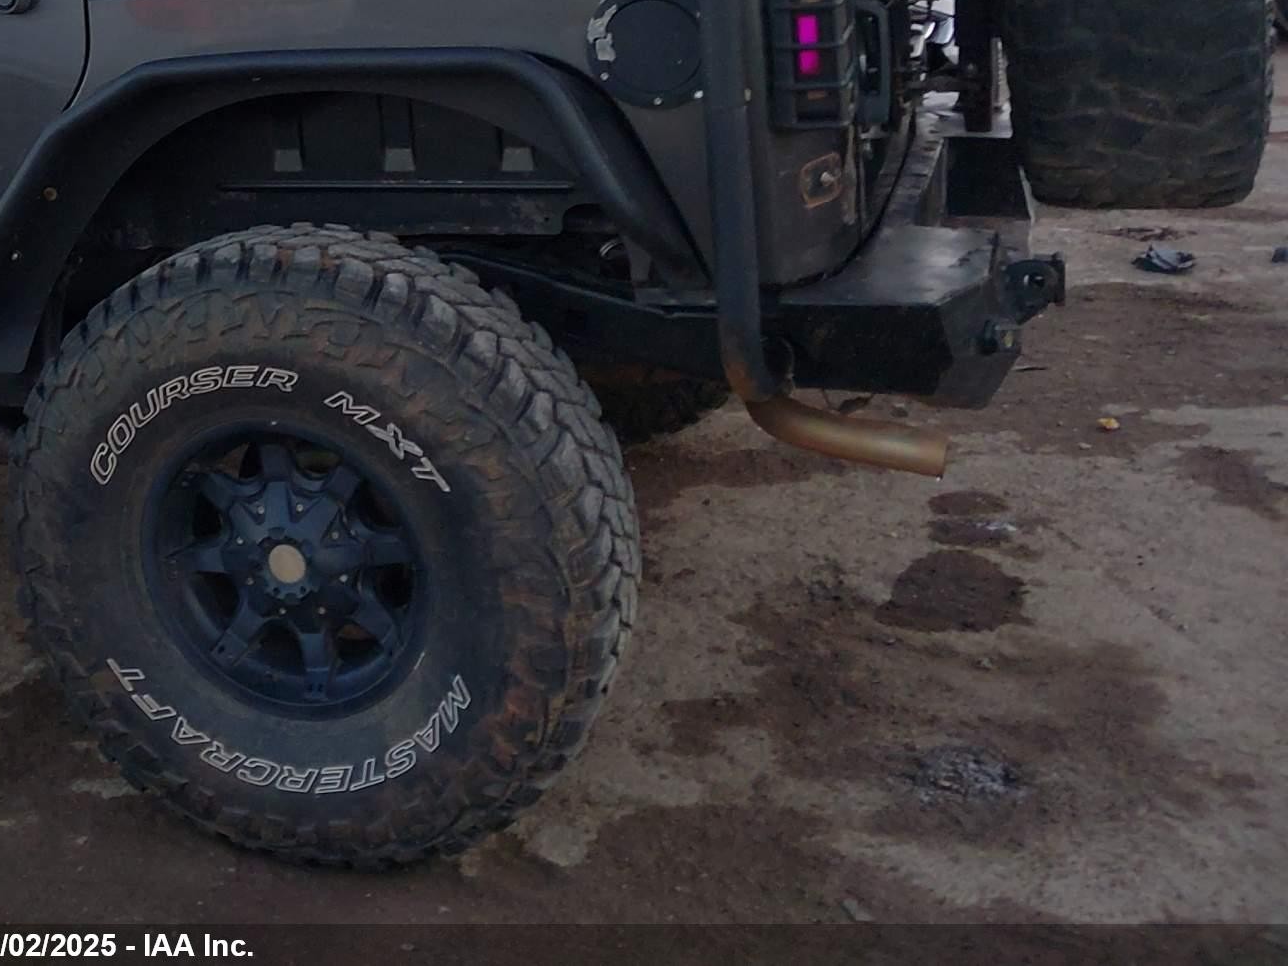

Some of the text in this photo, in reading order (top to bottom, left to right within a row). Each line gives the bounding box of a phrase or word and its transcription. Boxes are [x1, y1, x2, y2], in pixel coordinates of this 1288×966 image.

[90, 365, 451, 494] COURSER MXT
[105, 657, 473, 796] MASTERCRAFT
